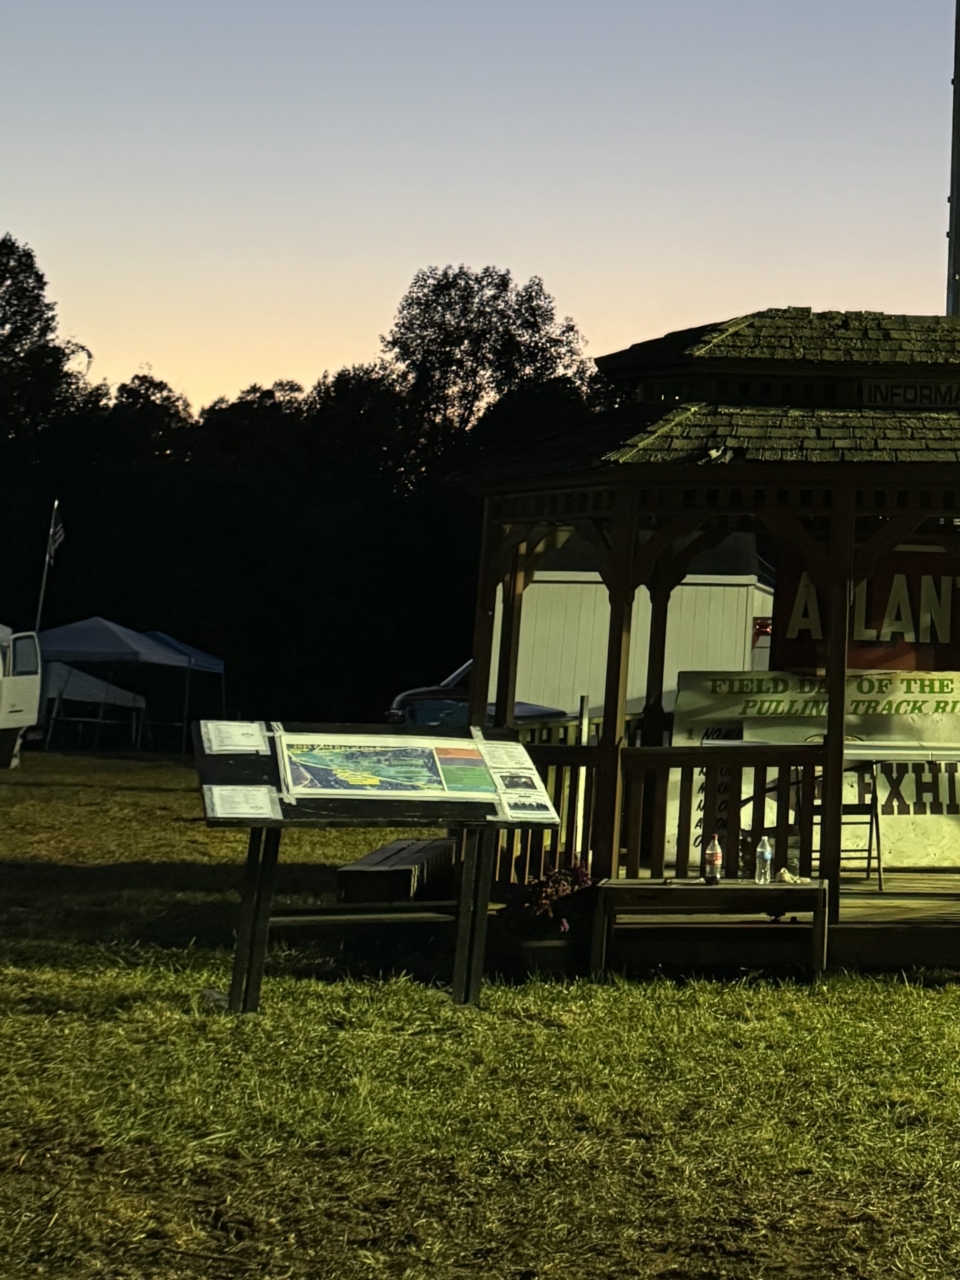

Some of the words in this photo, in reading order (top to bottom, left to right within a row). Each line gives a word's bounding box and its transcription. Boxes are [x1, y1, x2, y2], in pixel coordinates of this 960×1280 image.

[709, 677, 790, 694] FIELD
[797, 678, 832, 695] DA
[856, 678, 893, 695] OF
[900, 678, 955, 695] THE
[739, 699, 829, 716] PULLIN
[849, 699, 929, 716] TRACK
